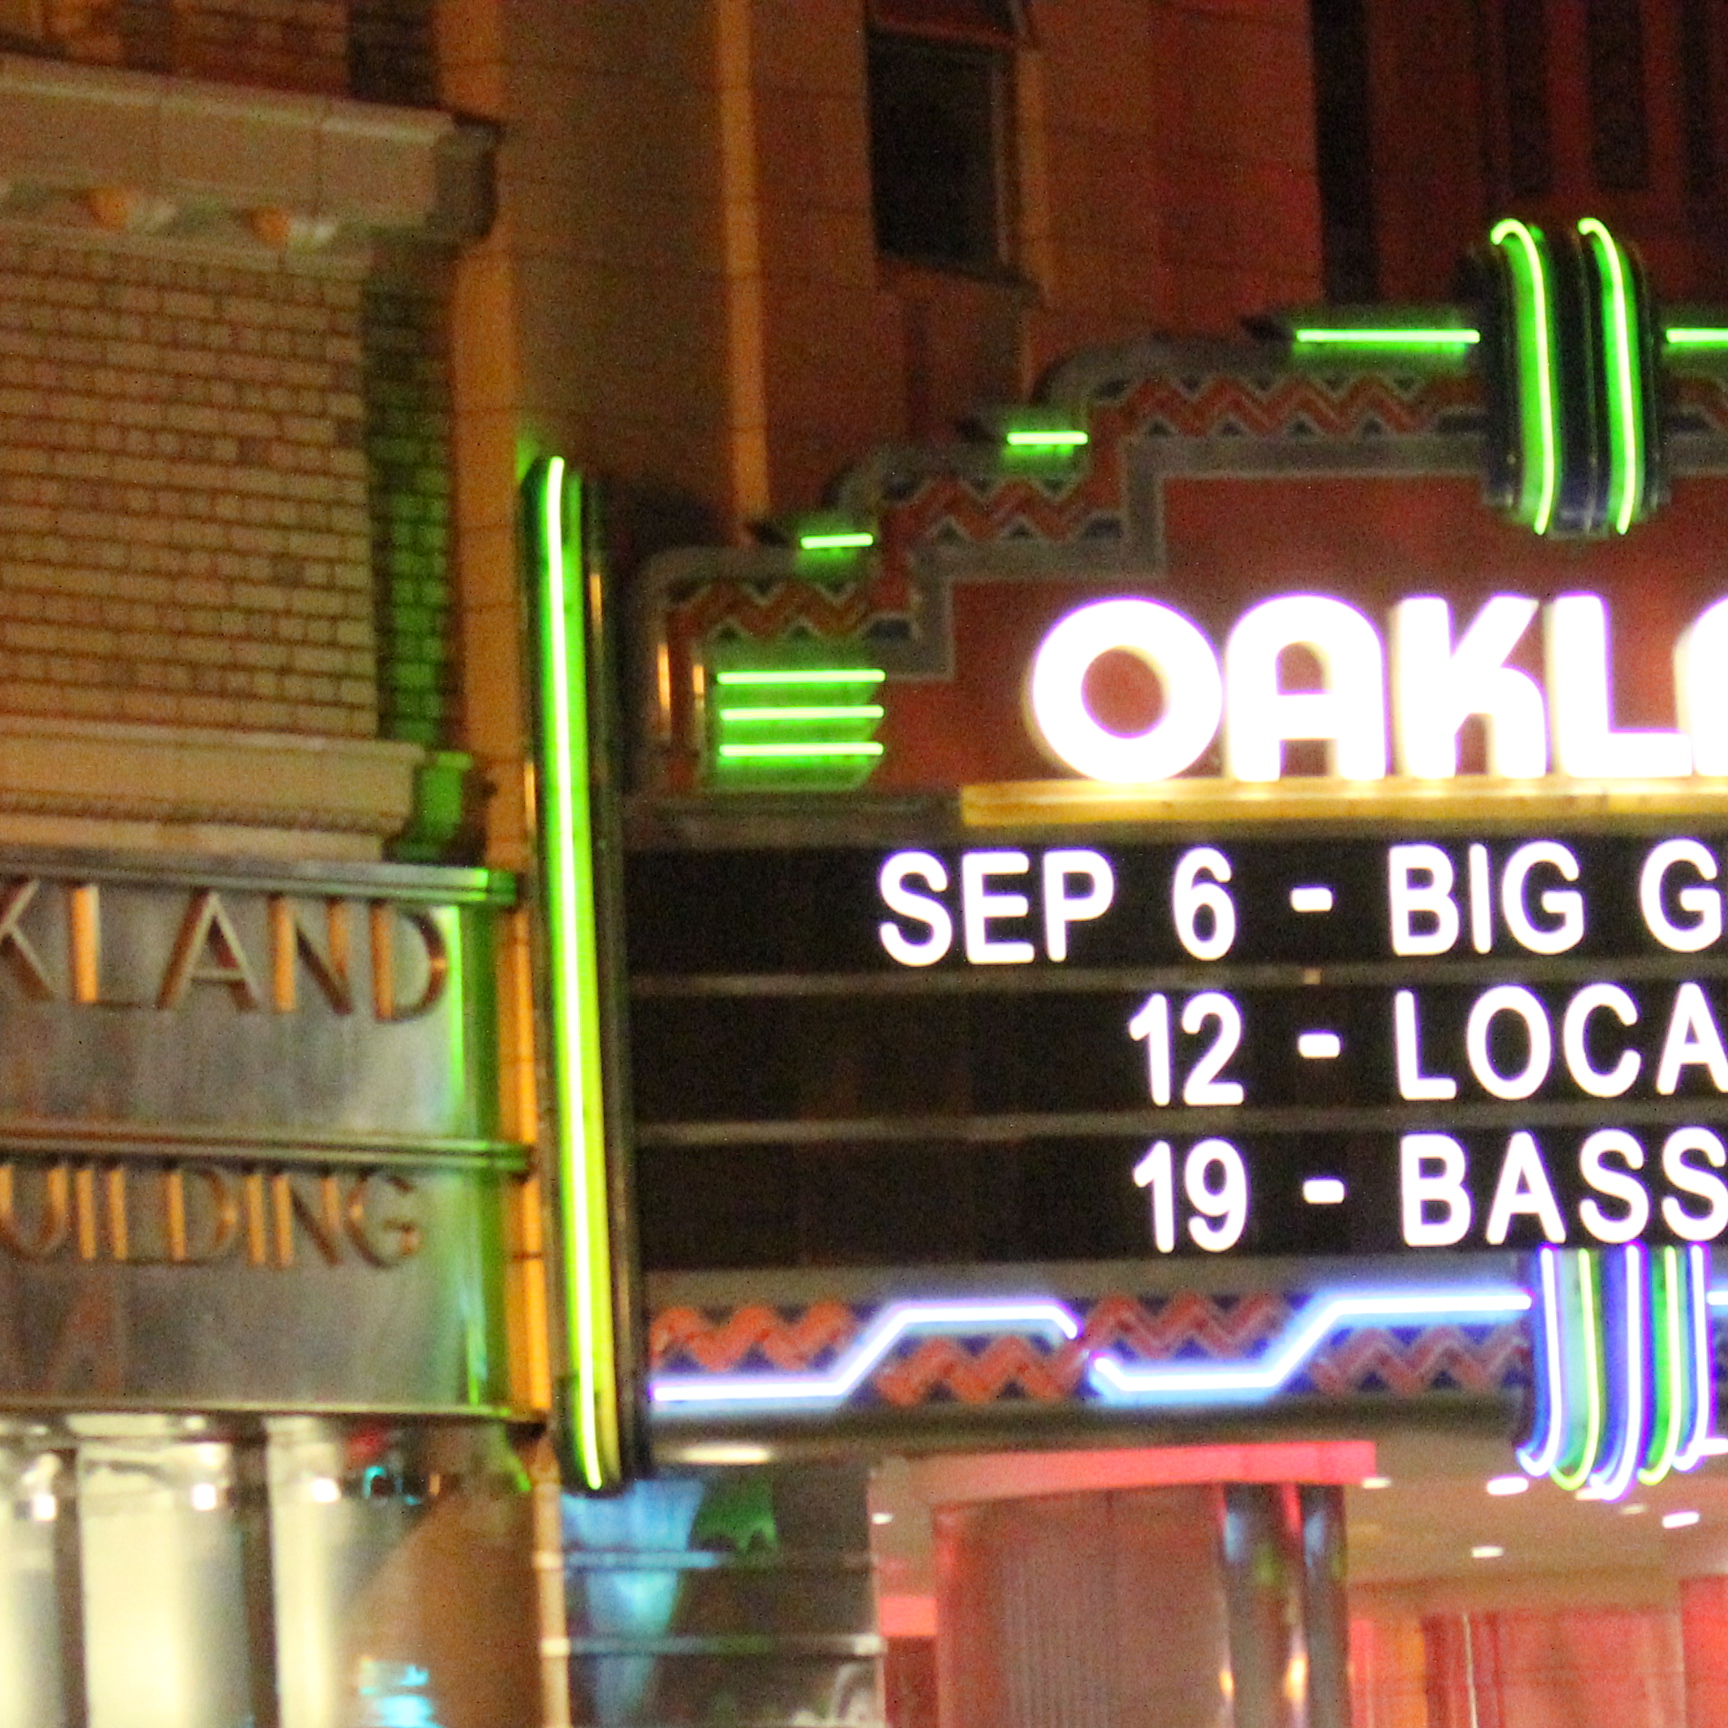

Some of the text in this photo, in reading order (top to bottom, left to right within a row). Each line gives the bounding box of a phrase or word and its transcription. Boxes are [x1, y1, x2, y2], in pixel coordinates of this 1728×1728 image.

[879, 850, 1115, 965] SEP
[1173, 847, 1236, 959] 6
[1389, 841, 1585, 955] BIG
[1128, 992, 1244, 1105] 12
[1133, 1140, 1248, 1253] 19
